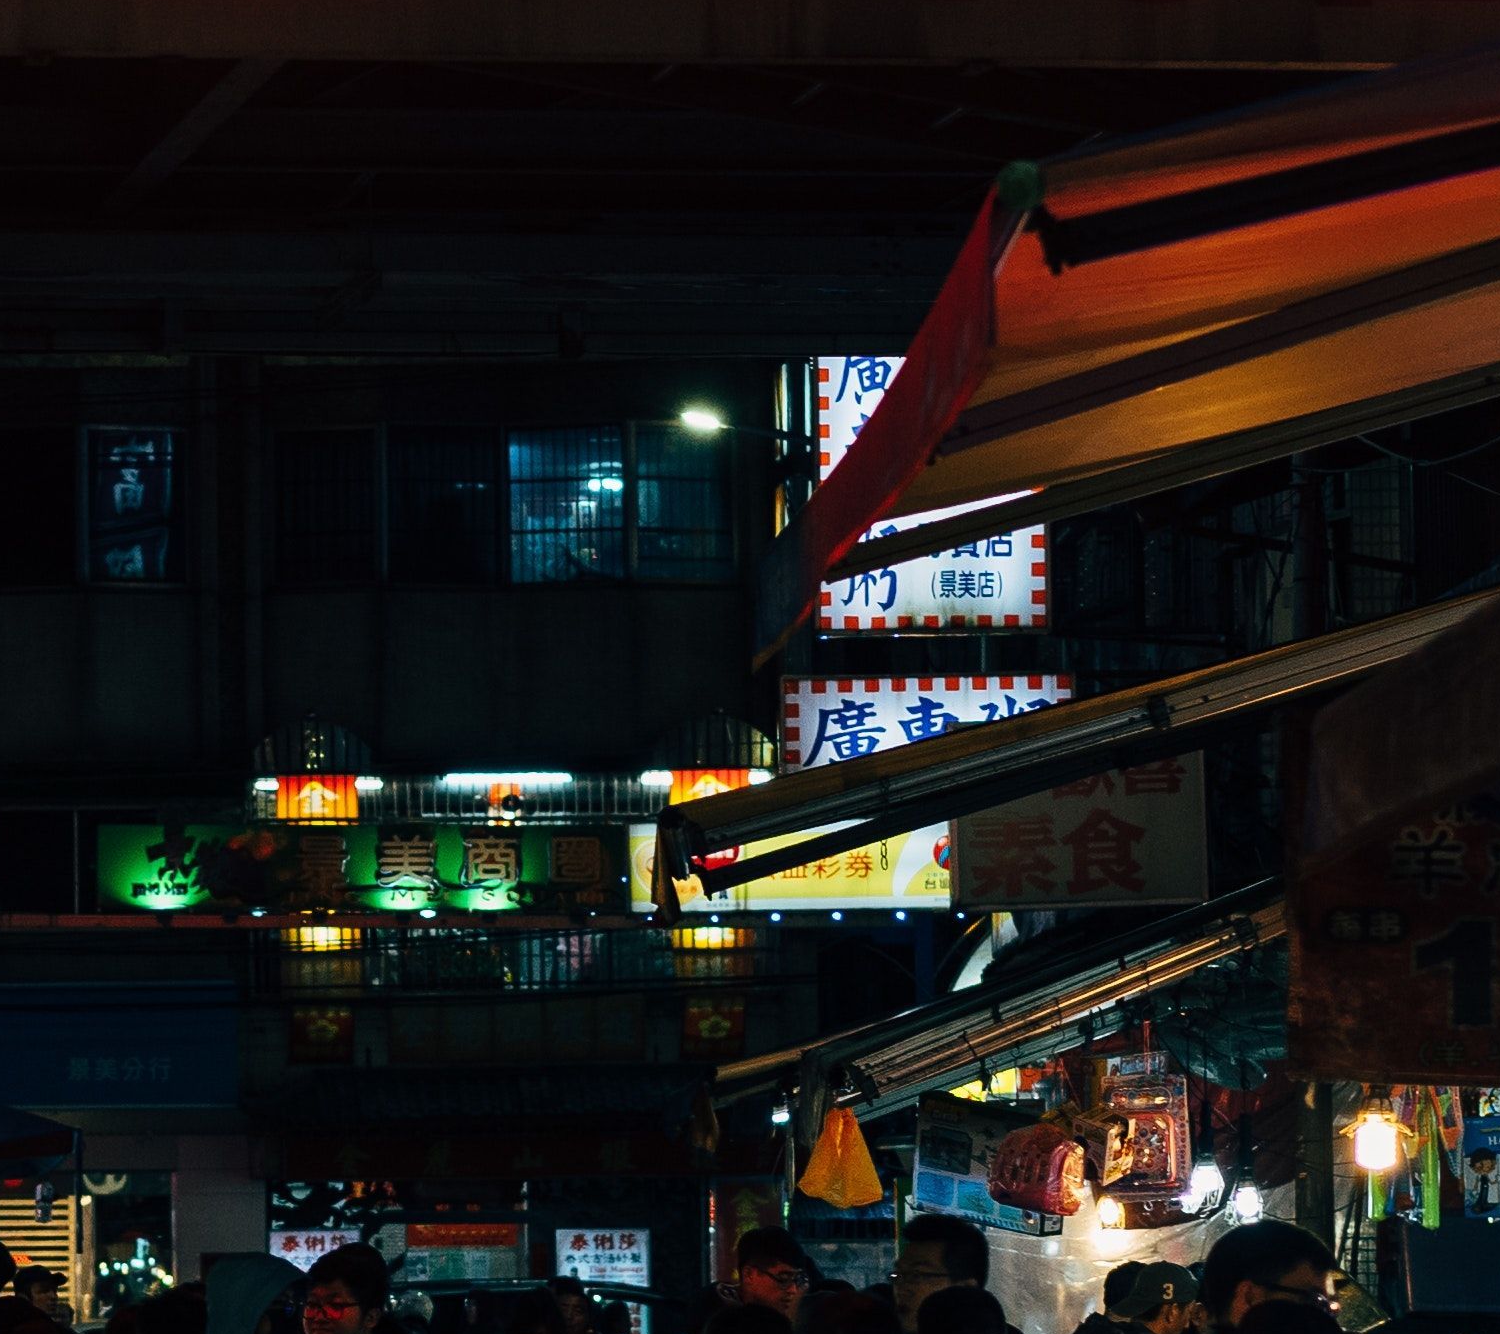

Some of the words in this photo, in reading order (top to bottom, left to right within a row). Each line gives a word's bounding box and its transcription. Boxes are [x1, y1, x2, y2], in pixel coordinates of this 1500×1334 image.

[296, 834, 603, 887] 景美商圈
[968, 807, 1147, 899] 素食
[67, 1055, 172, 1083] 景美分行
[1162, 1283, 1175, 1300] 3
